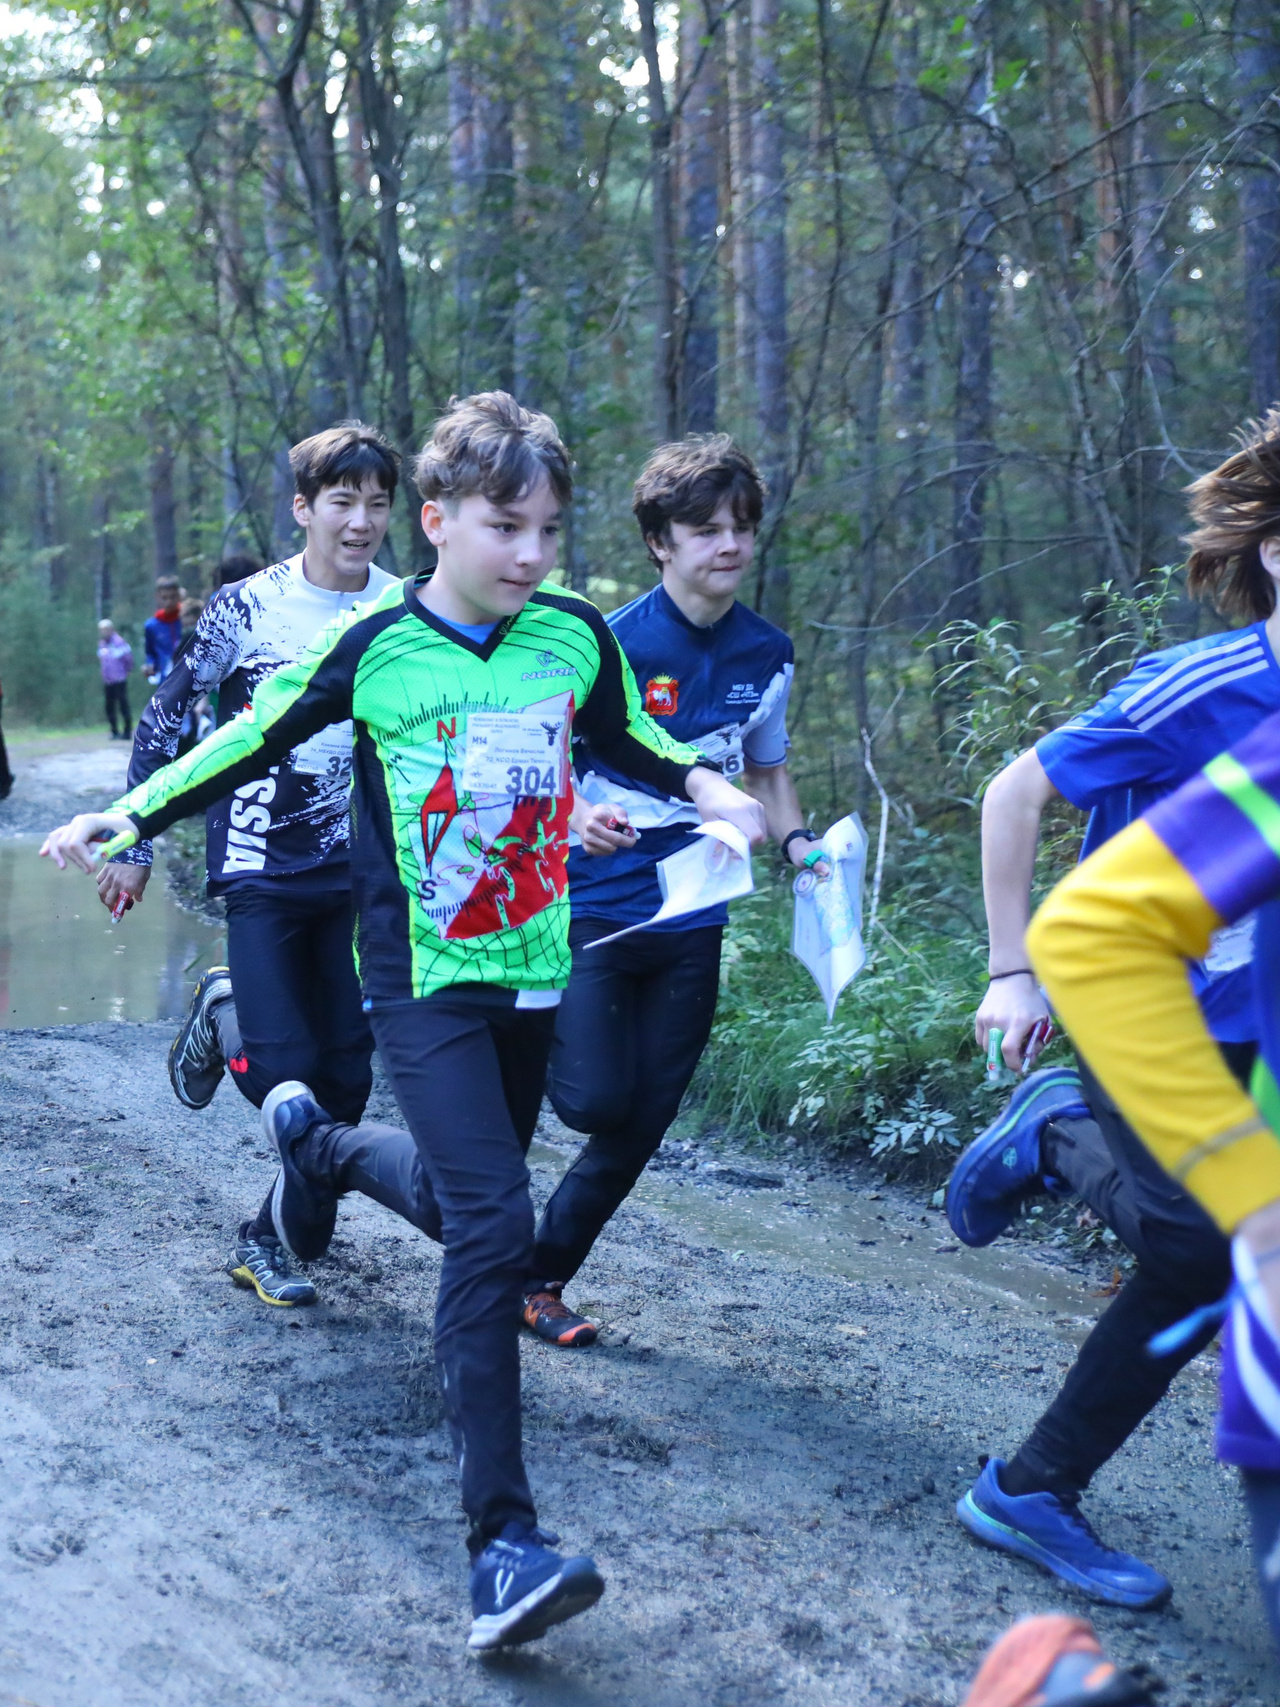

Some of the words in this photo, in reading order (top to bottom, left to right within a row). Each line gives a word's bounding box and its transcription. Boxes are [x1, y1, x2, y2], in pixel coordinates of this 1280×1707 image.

[521, 667, 577, 681] NORD
[437, 717, 456, 742] N
[505, 766, 556, 795] 304
[421, 879, 436, 900] S
